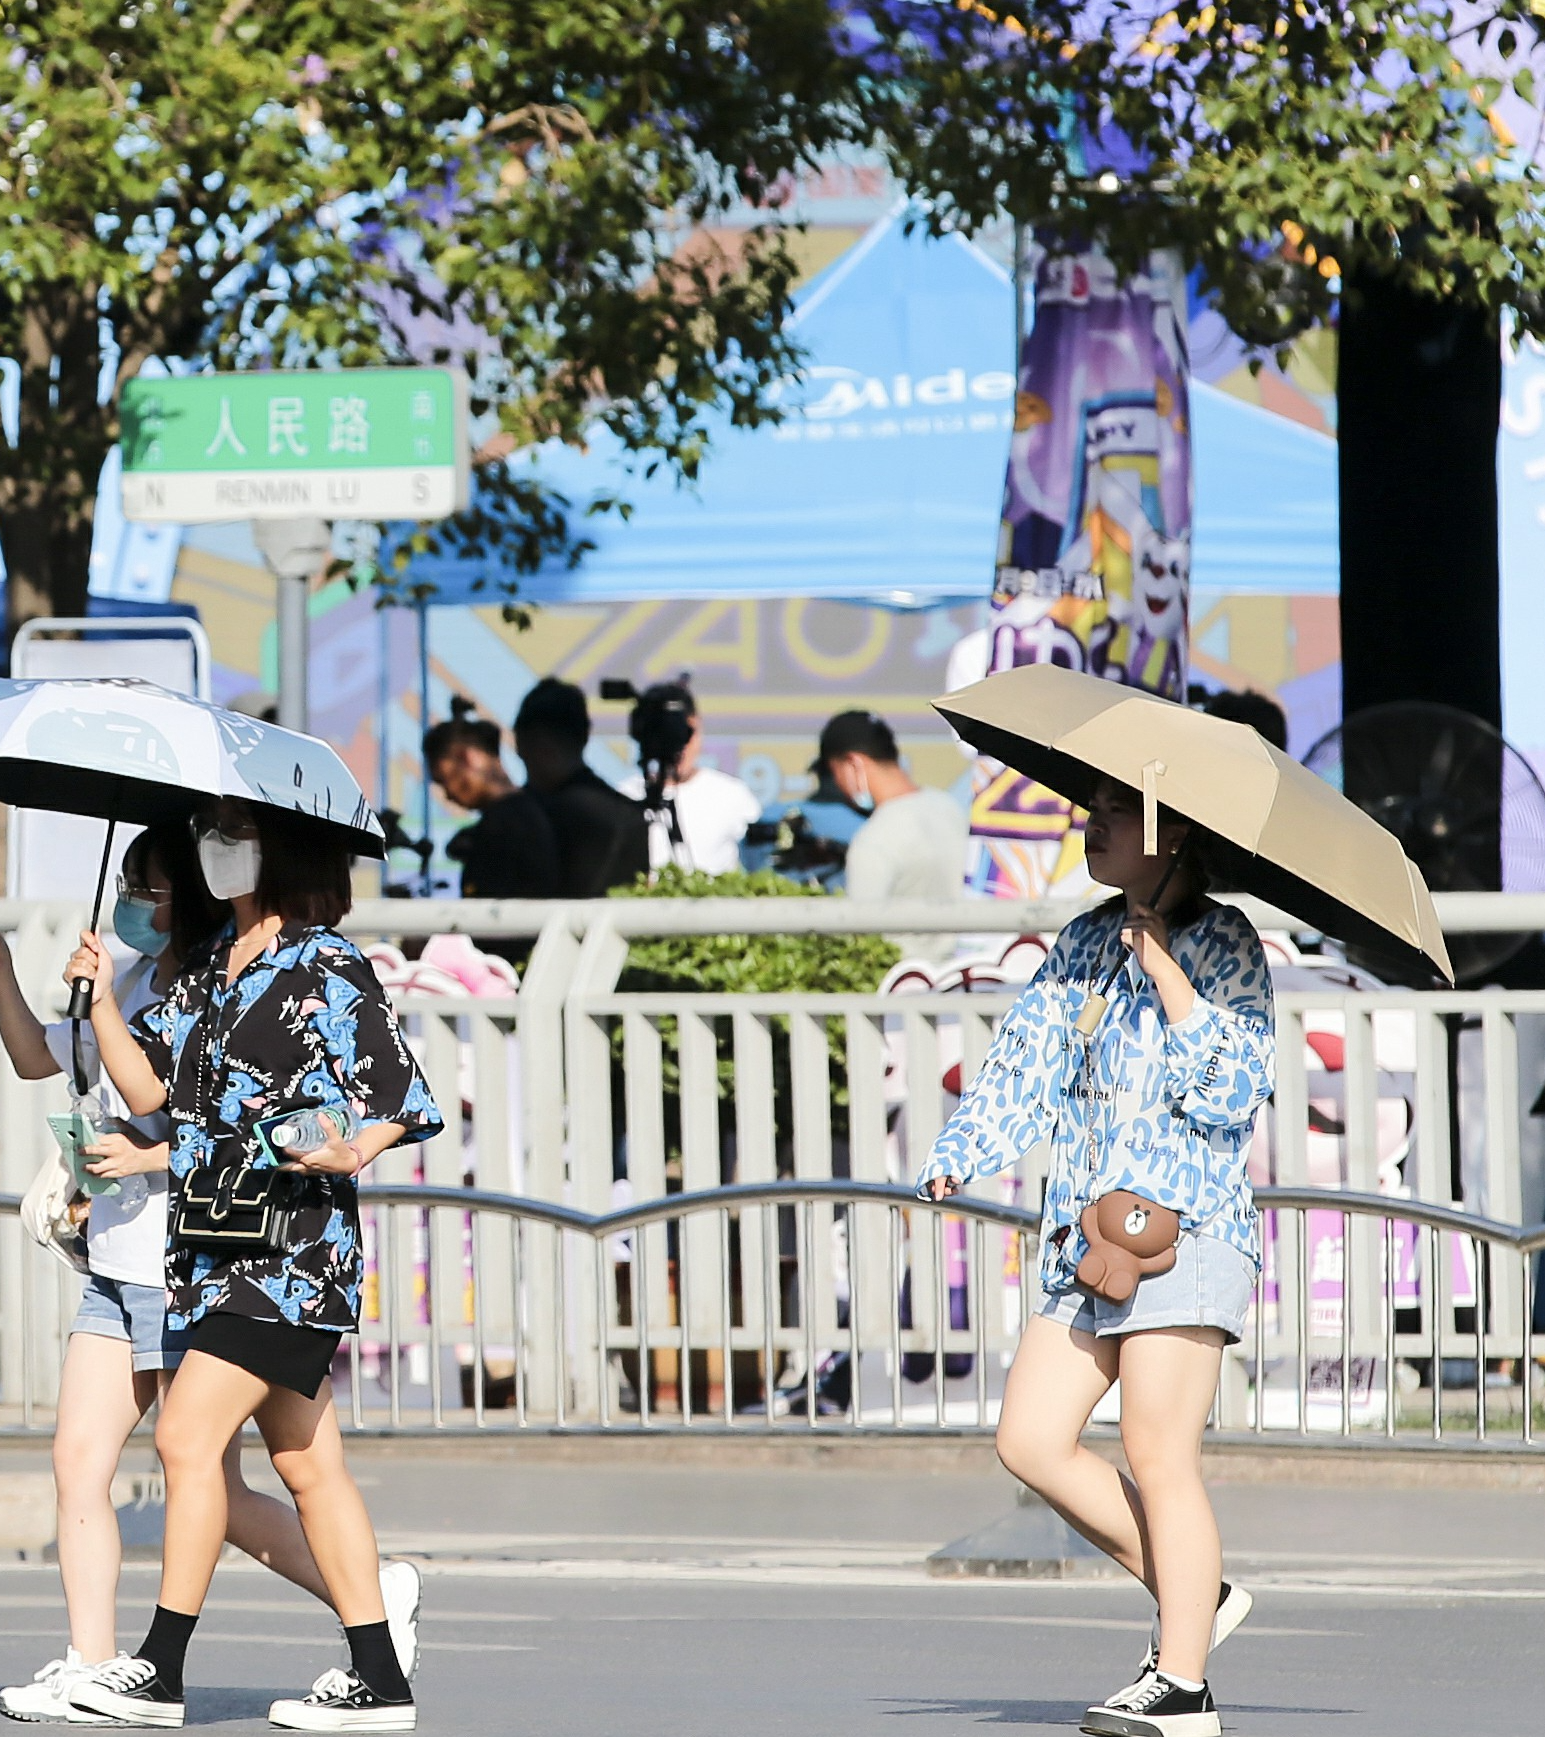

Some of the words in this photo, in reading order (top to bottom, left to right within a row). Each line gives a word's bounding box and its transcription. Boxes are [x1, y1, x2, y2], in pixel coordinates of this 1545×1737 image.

[206, 395, 369, 457] 人民路
[145, 481, 165, 507] N
[216, 478, 311, 506] RENMIN
[327, 476, 361, 501] LU
[412, 473, 430, 503] S
